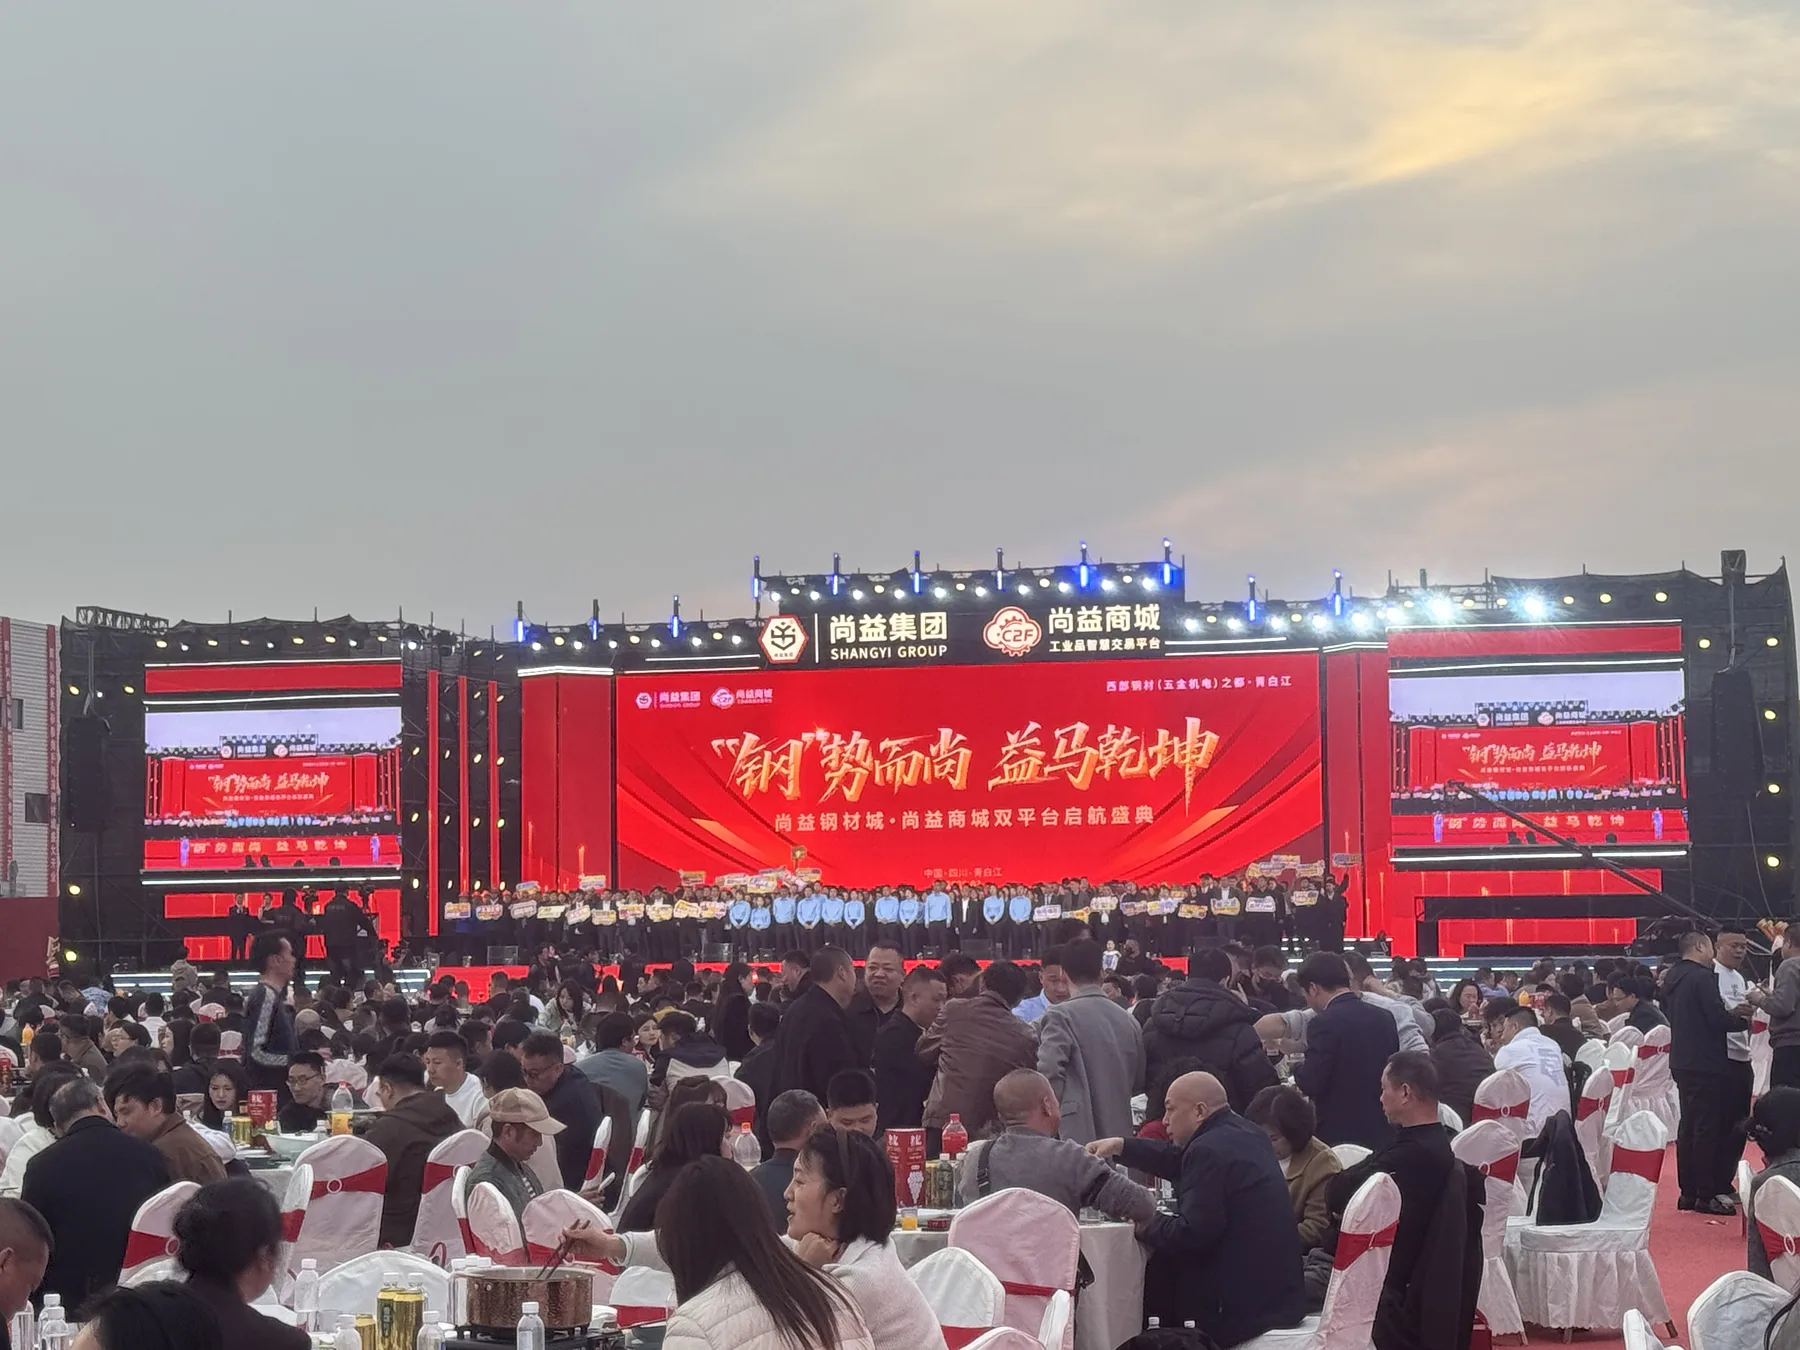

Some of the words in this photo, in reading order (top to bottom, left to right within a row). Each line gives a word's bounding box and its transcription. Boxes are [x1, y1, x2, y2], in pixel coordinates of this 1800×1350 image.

[830, 611, 948, 644] 尚益集团
[1048, 603, 1161, 634] 尚益商城
[1002, 628, 1035, 643] C2F
[1048, 636, 1161, 653] 工业品智慧交易平台
[830, 646, 892, 661] SHANGYI
[897, 644, 948, 659] GROUP
[987, 716, 1221, 818] 益马乾坤
[774, 805, 1155, 832] 尚益钢材城·尚益商城双平台启航盛典
